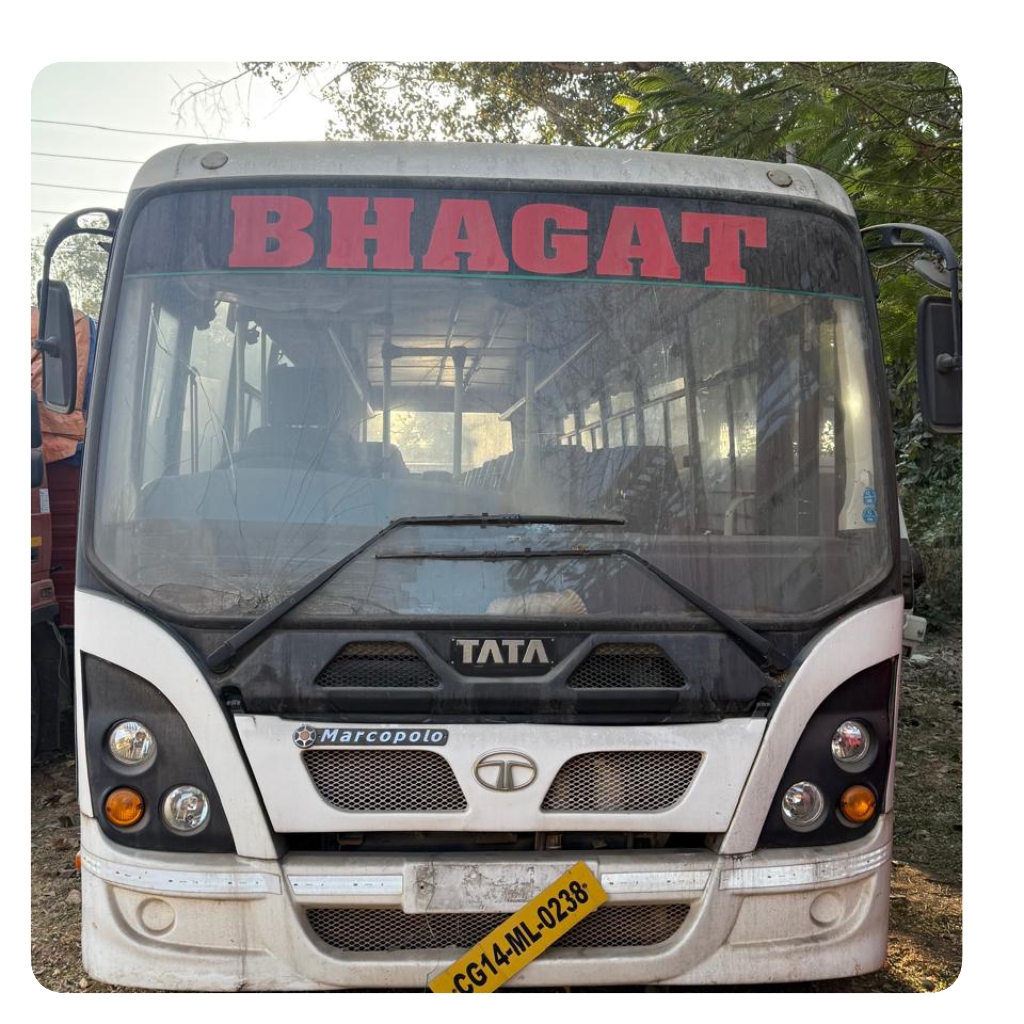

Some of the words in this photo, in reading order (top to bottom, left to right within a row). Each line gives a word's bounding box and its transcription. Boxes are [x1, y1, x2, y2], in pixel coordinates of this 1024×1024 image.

[228, 195, 768, 284] BHAGAT
[456, 639, 549, 664] TATA
[320, 728, 444, 745] Marcopolo
[453, 880, 589, 993] CG14-ML-0238
